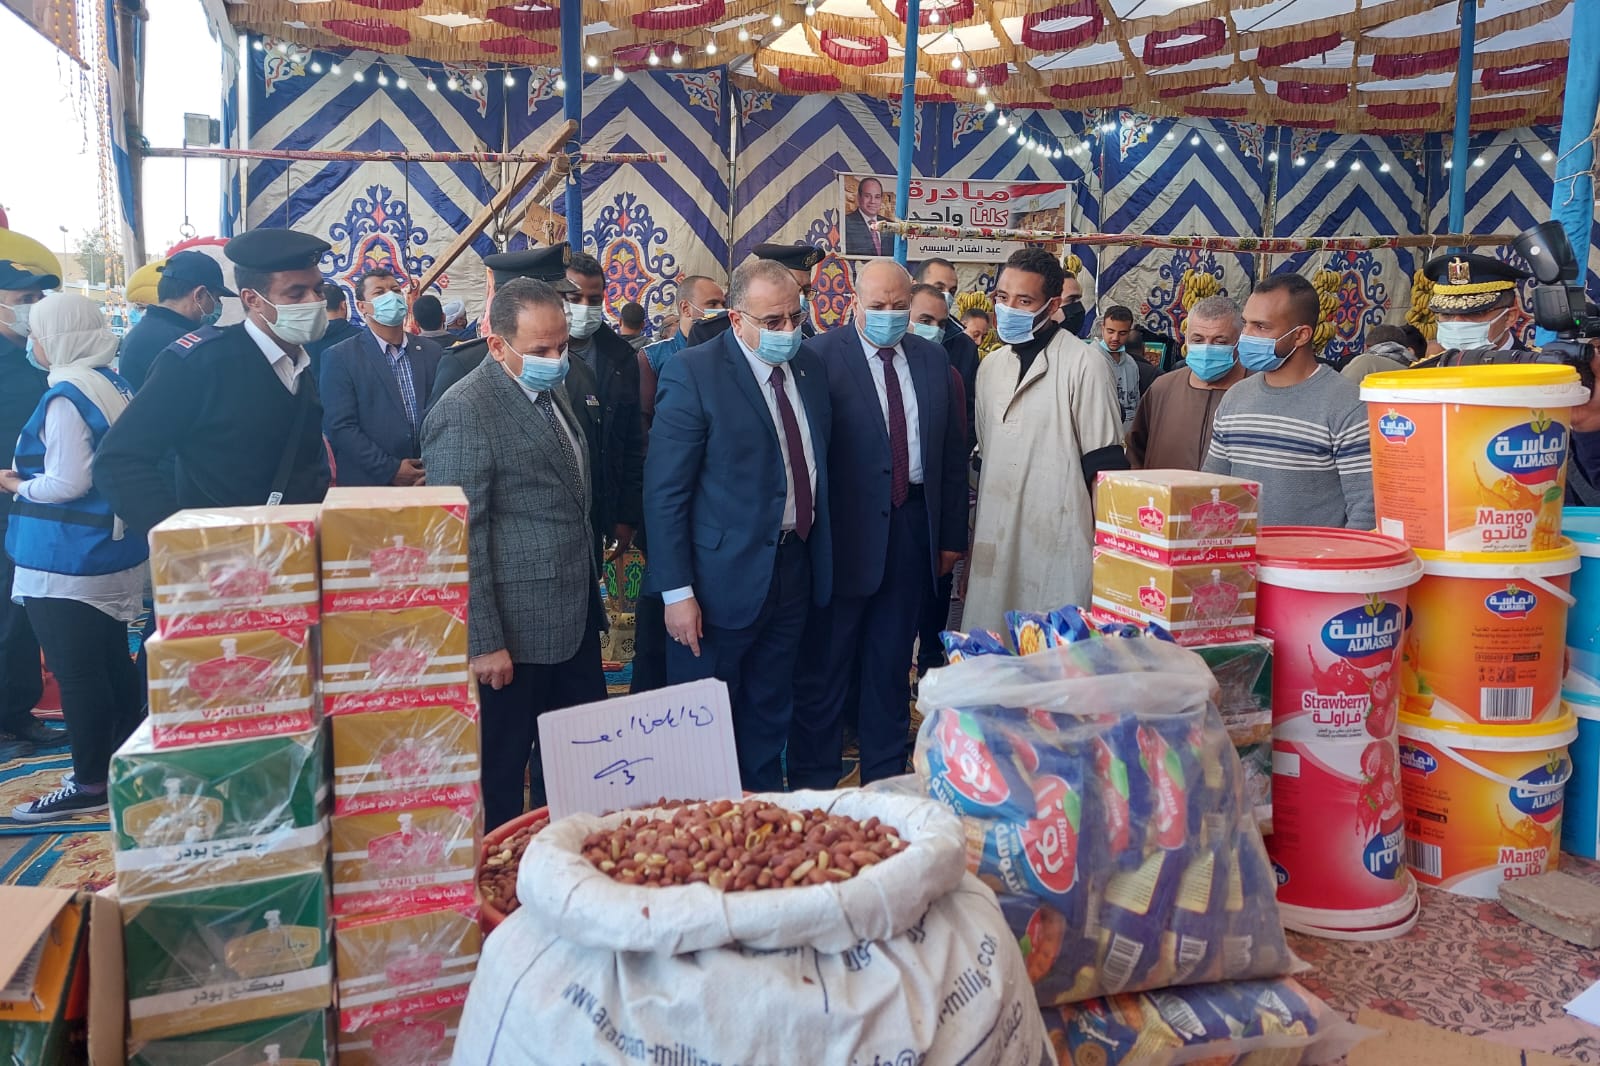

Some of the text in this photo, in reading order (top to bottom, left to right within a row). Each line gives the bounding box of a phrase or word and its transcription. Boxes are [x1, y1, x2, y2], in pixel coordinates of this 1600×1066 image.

[909, 181, 1010, 206] مبادرة
[909, 206, 1008, 227] كلنا واحد
[919, 244, 1001, 255] عبد الفتاح السيسي
[1495, 431, 1566, 456] الماسة
[1513, 453, 1558, 468] ALMASSA
[1478, 510, 1533, 529] Mango
[1482, 526, 1527, 544] مانجو
[1329, 611, 1401, 639] الماسة
[1348, 634, 1393, 652] ALMASSA
[1304, 693, 1369, 711] Strawberry
[1313, 710, 1362, 727] فراولة
[1500, 847, 1546, 866] Mango
[1503, 864, 1542, 881] مانجو
